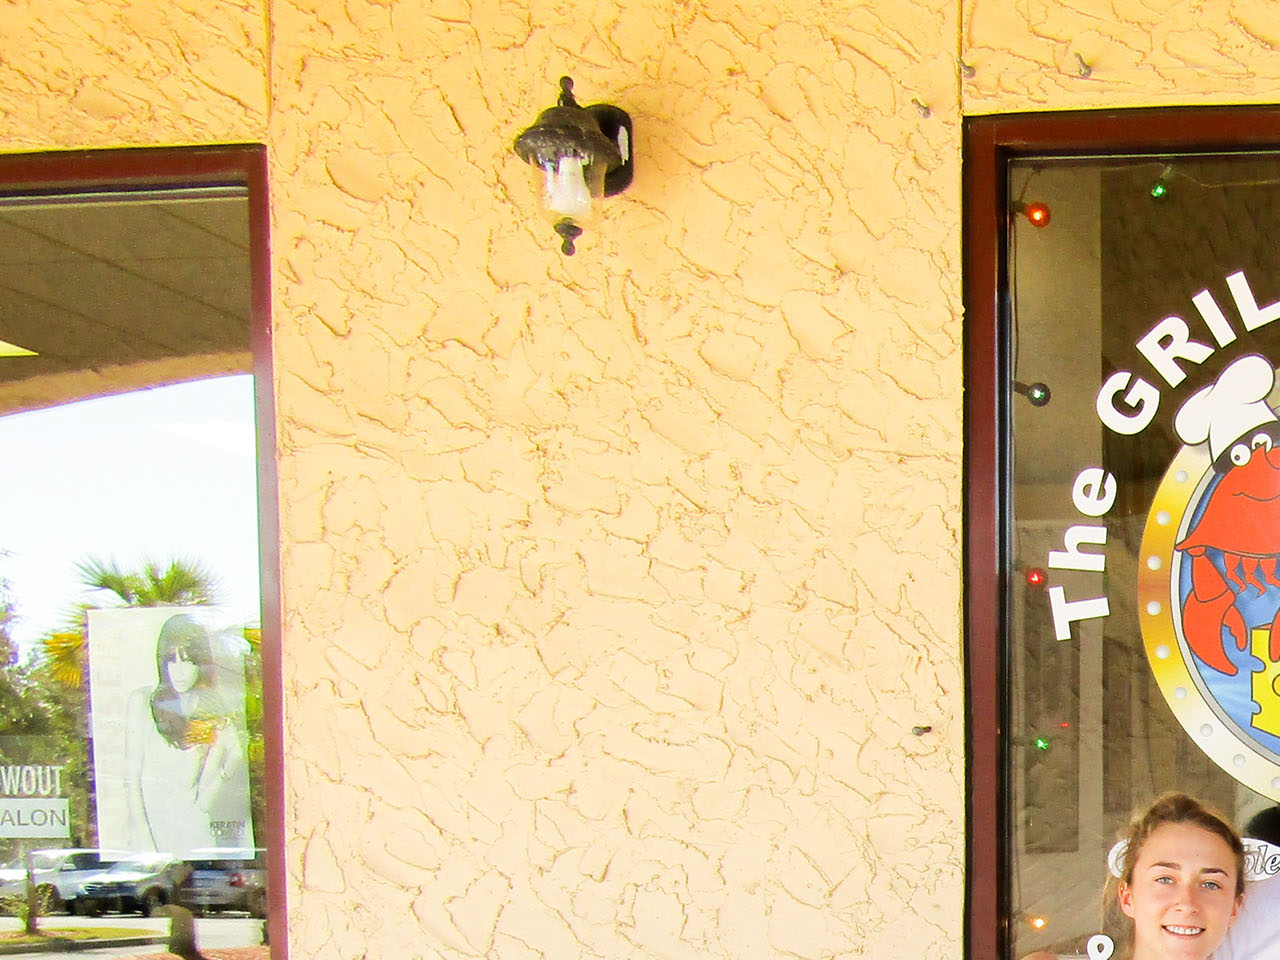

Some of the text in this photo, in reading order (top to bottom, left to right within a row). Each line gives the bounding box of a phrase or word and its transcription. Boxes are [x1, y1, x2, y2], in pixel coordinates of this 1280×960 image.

[1048, 466, 1119, 641] The
[0, 765, 65, 796] WOUT
[0, 808, 66, 827] ALON
